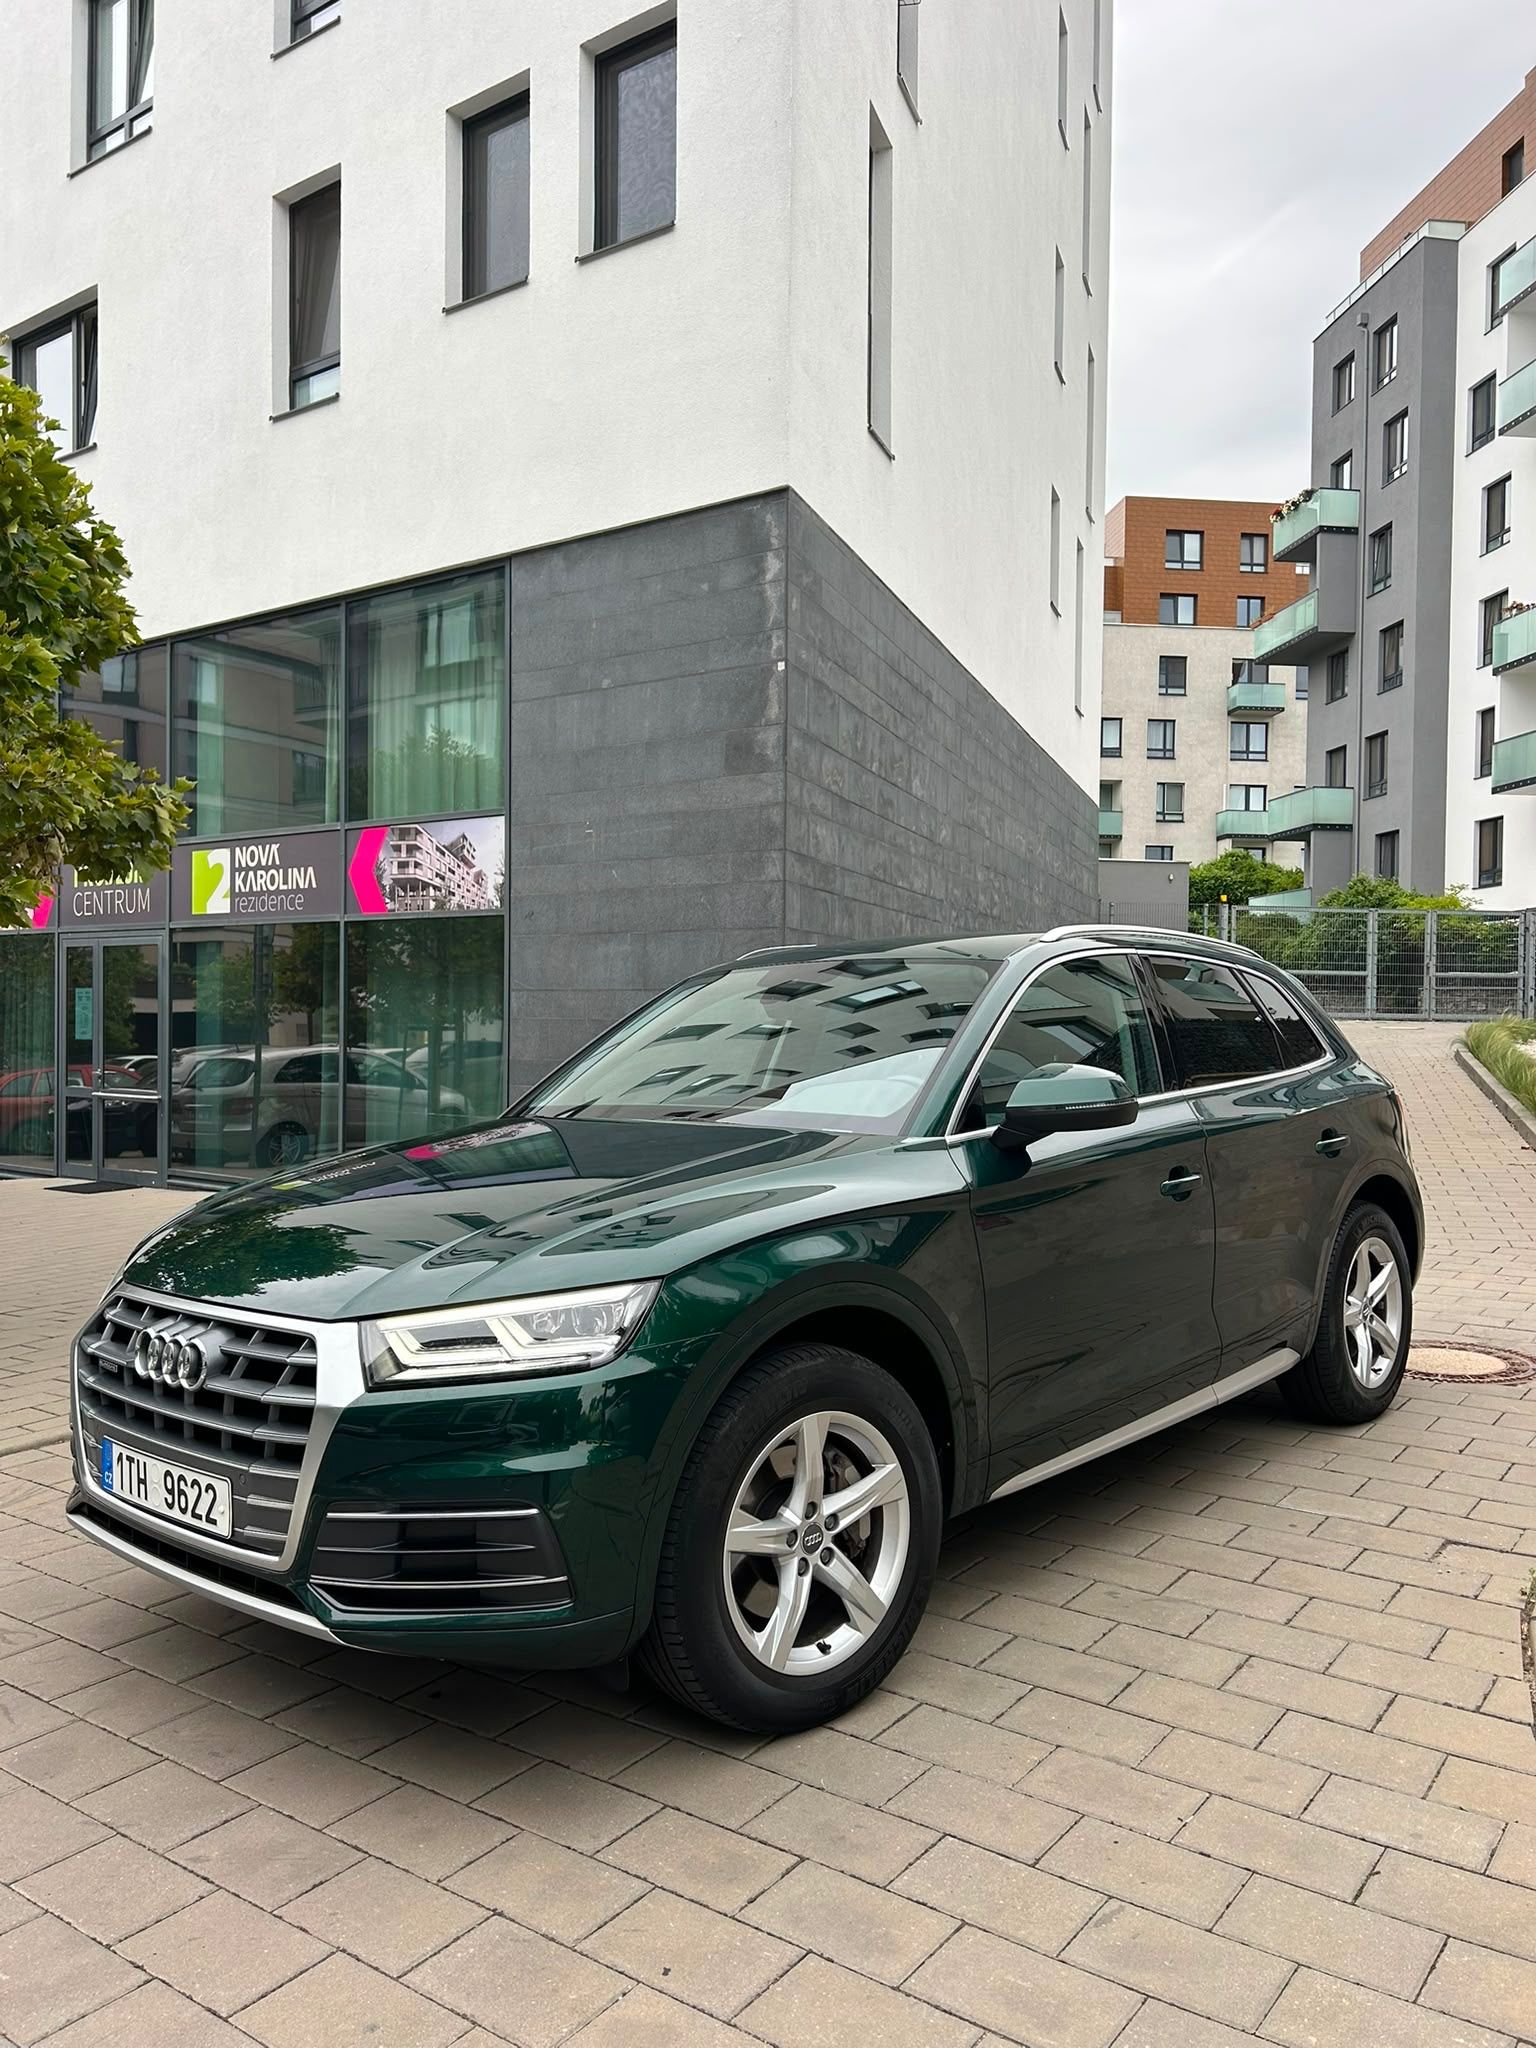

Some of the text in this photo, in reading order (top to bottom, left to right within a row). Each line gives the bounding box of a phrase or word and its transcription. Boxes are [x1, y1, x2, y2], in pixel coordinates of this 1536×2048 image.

[235, 866, 317, 893] KAROLINA
[73, 887, 150, 916] CENTRUM
[235, 893, 304, 913] rezidence
[104, 1471, 113, 1484] CZ
[117, 1452, 217, 1526] 1TH 9622
